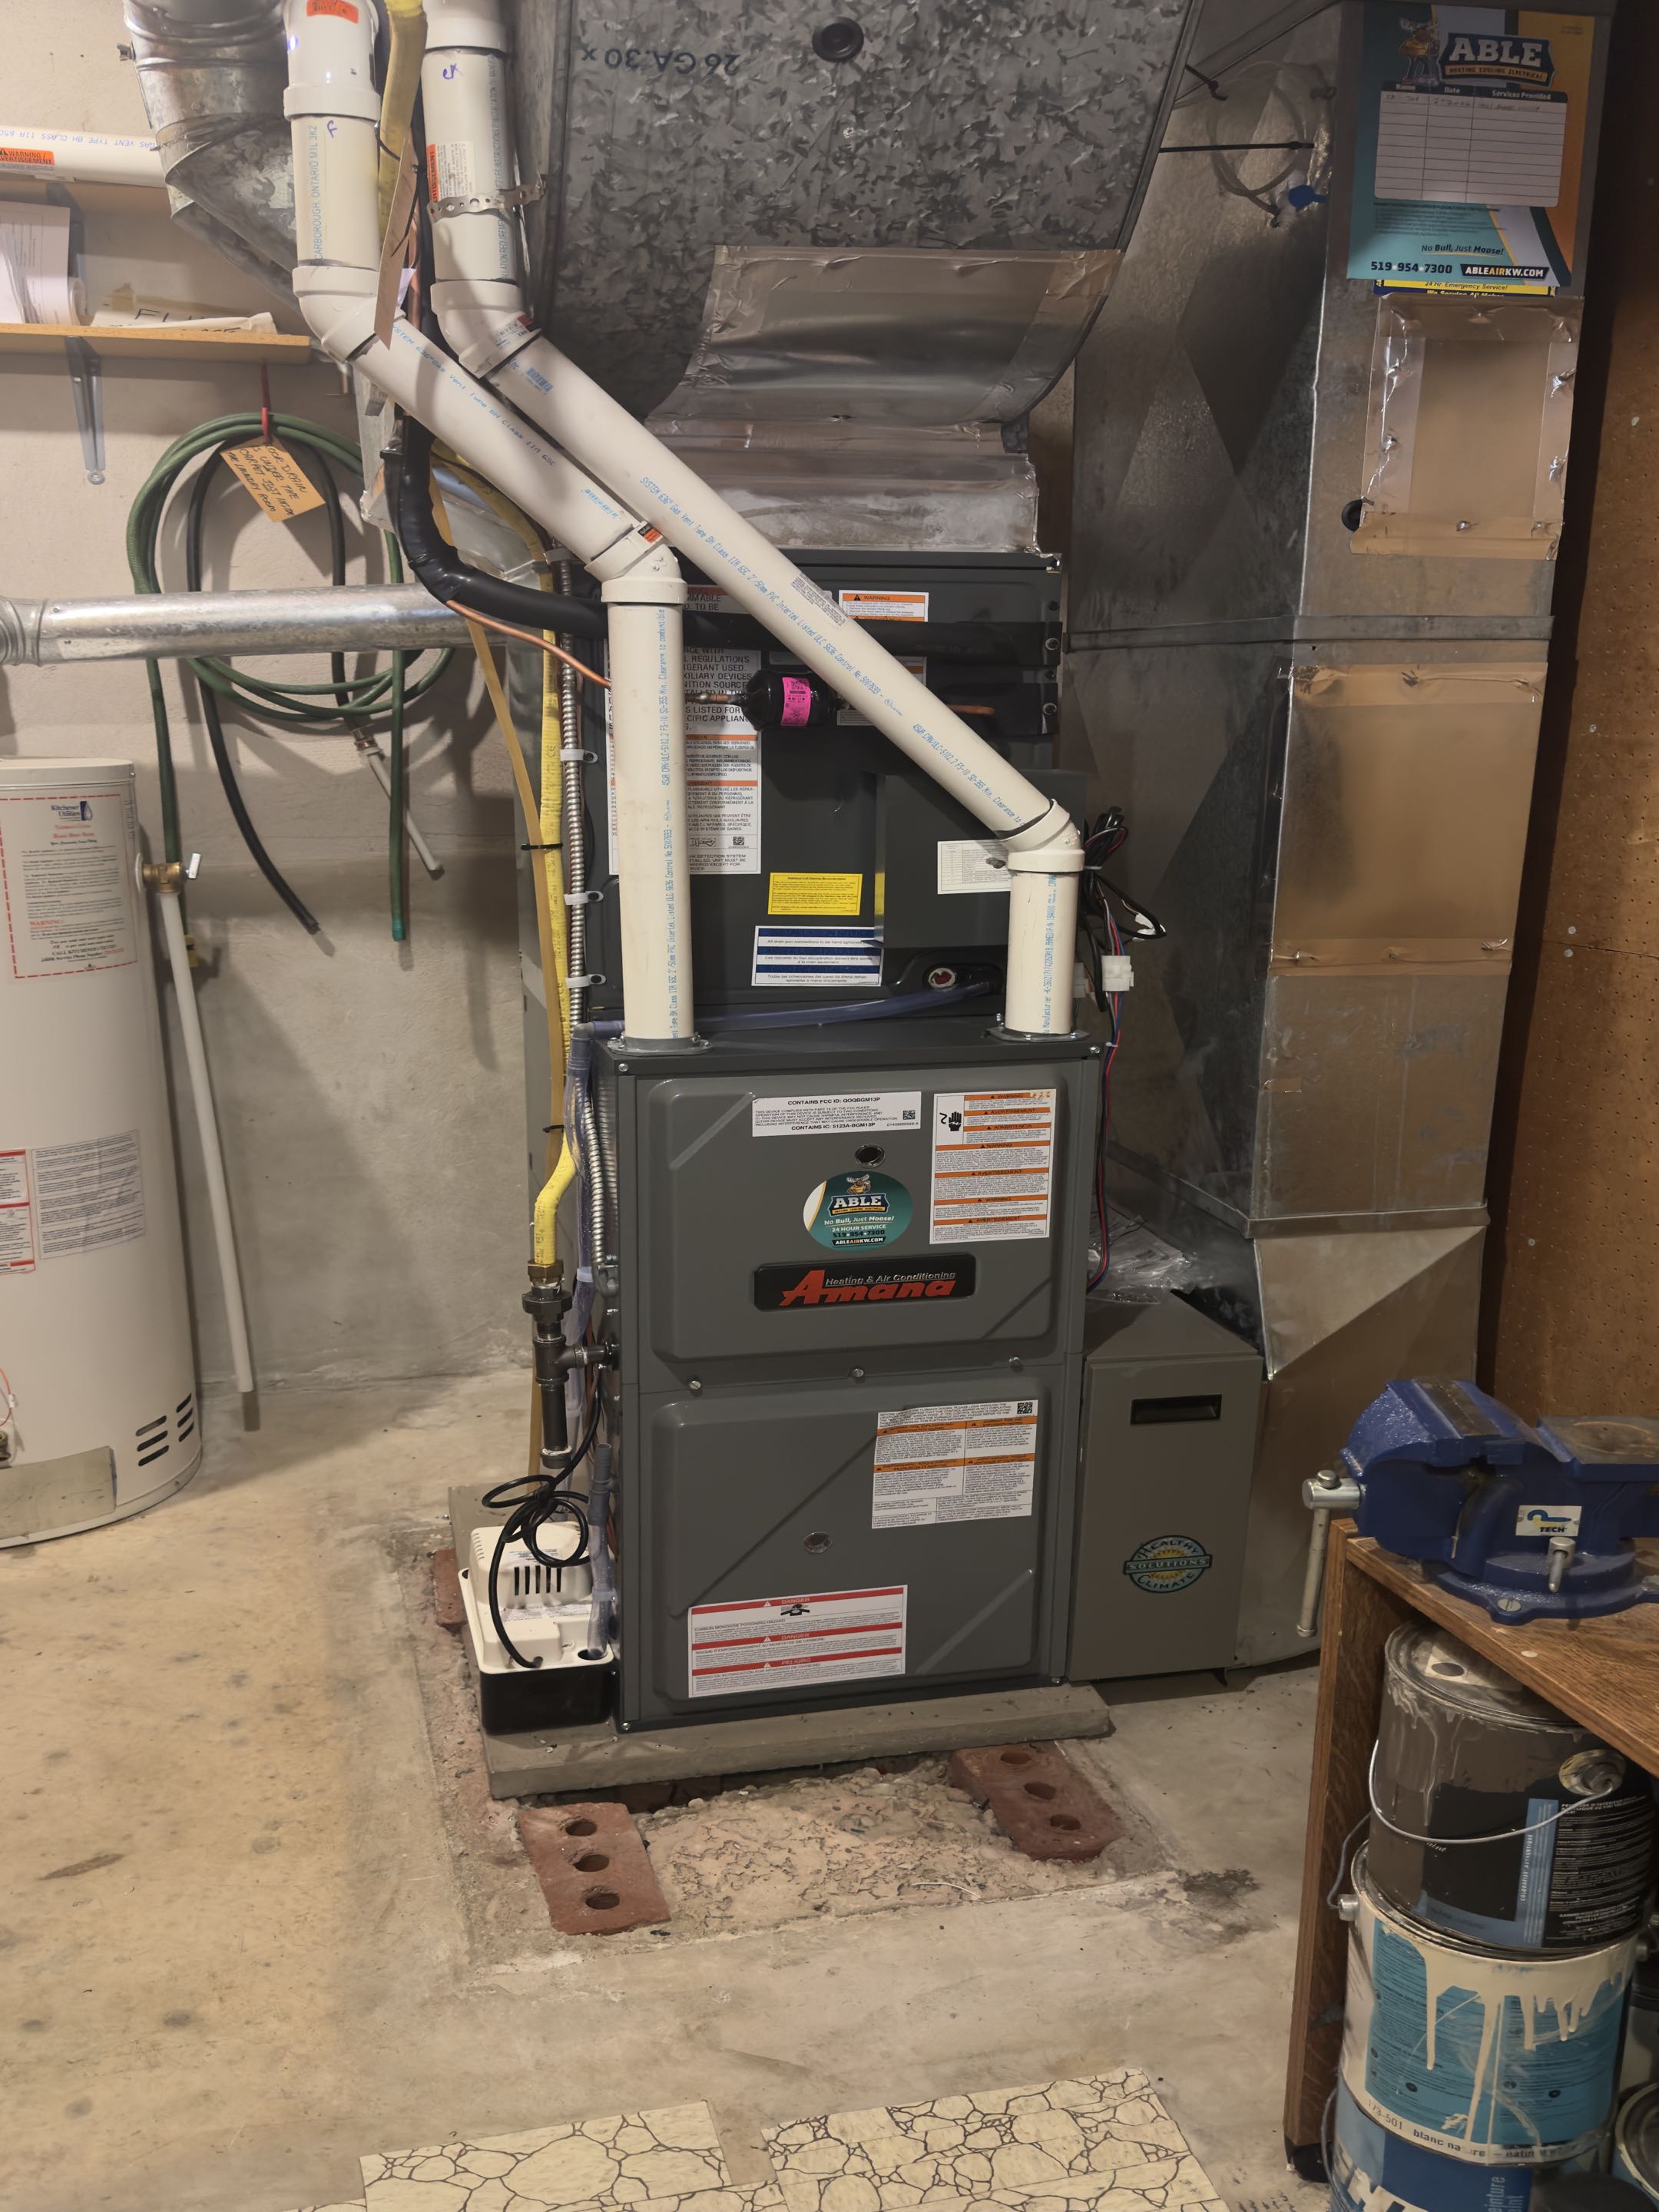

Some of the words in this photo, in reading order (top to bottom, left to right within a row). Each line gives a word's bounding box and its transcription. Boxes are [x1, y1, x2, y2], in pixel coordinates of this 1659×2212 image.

[1449, 38, 1542, 68] ABLE
[704, 54, 740, 76] 26
[1492, 90, 1519, 98] Services
[41, 133, 67, 141] CLASS
[0, 156, 51, 164] VERTISSEMENT
[310, 161, 320, 198] ONTARIO
[313, 201, 323, 264] CARBOROUGH,
[1435, 244, 1452, 253] Bull,
[1473, 246, 1505, 255] Moose!
[1465, 266, 1543, 277] ABLEAIRKW.COM
[240, 449, 265, 475] CARPET
[262, 478, 281, 495] JUST
[260, 456, 283, 481] UNDER
[283, 485, 299, 499] THE
[282, 464, 307, 493] DRAIN
[259, 493, 276, 512] ROOM
[640, 476, 661, 495] SYSTEM
[670, 504, 680, 515] Gas
[681, 513, 694, 526] Vent
[695, 525, 707, 538] Type
[713, 542, 729, 558] Class
[768, 591, 780, 601] PVC
[797, 619, 816, 636] Listed
[814, 635, 826, 645] ULC
[835, 654, 854, 672] Control
[992, 796, 1015, 817] Clearance
[833, 1196, 882, 1208] ABLE
[779, 1270, 956, 1306] Amana
[826, 1274, 864, 1286] Heating
[866, 1275, 874, 1283] &
[876, 1273, 891, 1282] Air
[893, 1272, 955, 1281] Conditioning
[1137, 1540, 1199, 1559] HEALTHY
[1129, 1558, 1206, 1569] SOLUTIONS
[1137, 1572, 1194, 1589] CLIMATE
[1412, 2128, 1444, 2146] blanc
[1447, 2141, 1485, 2157] nare
[1485, 2176, 1505, 2212] einture
